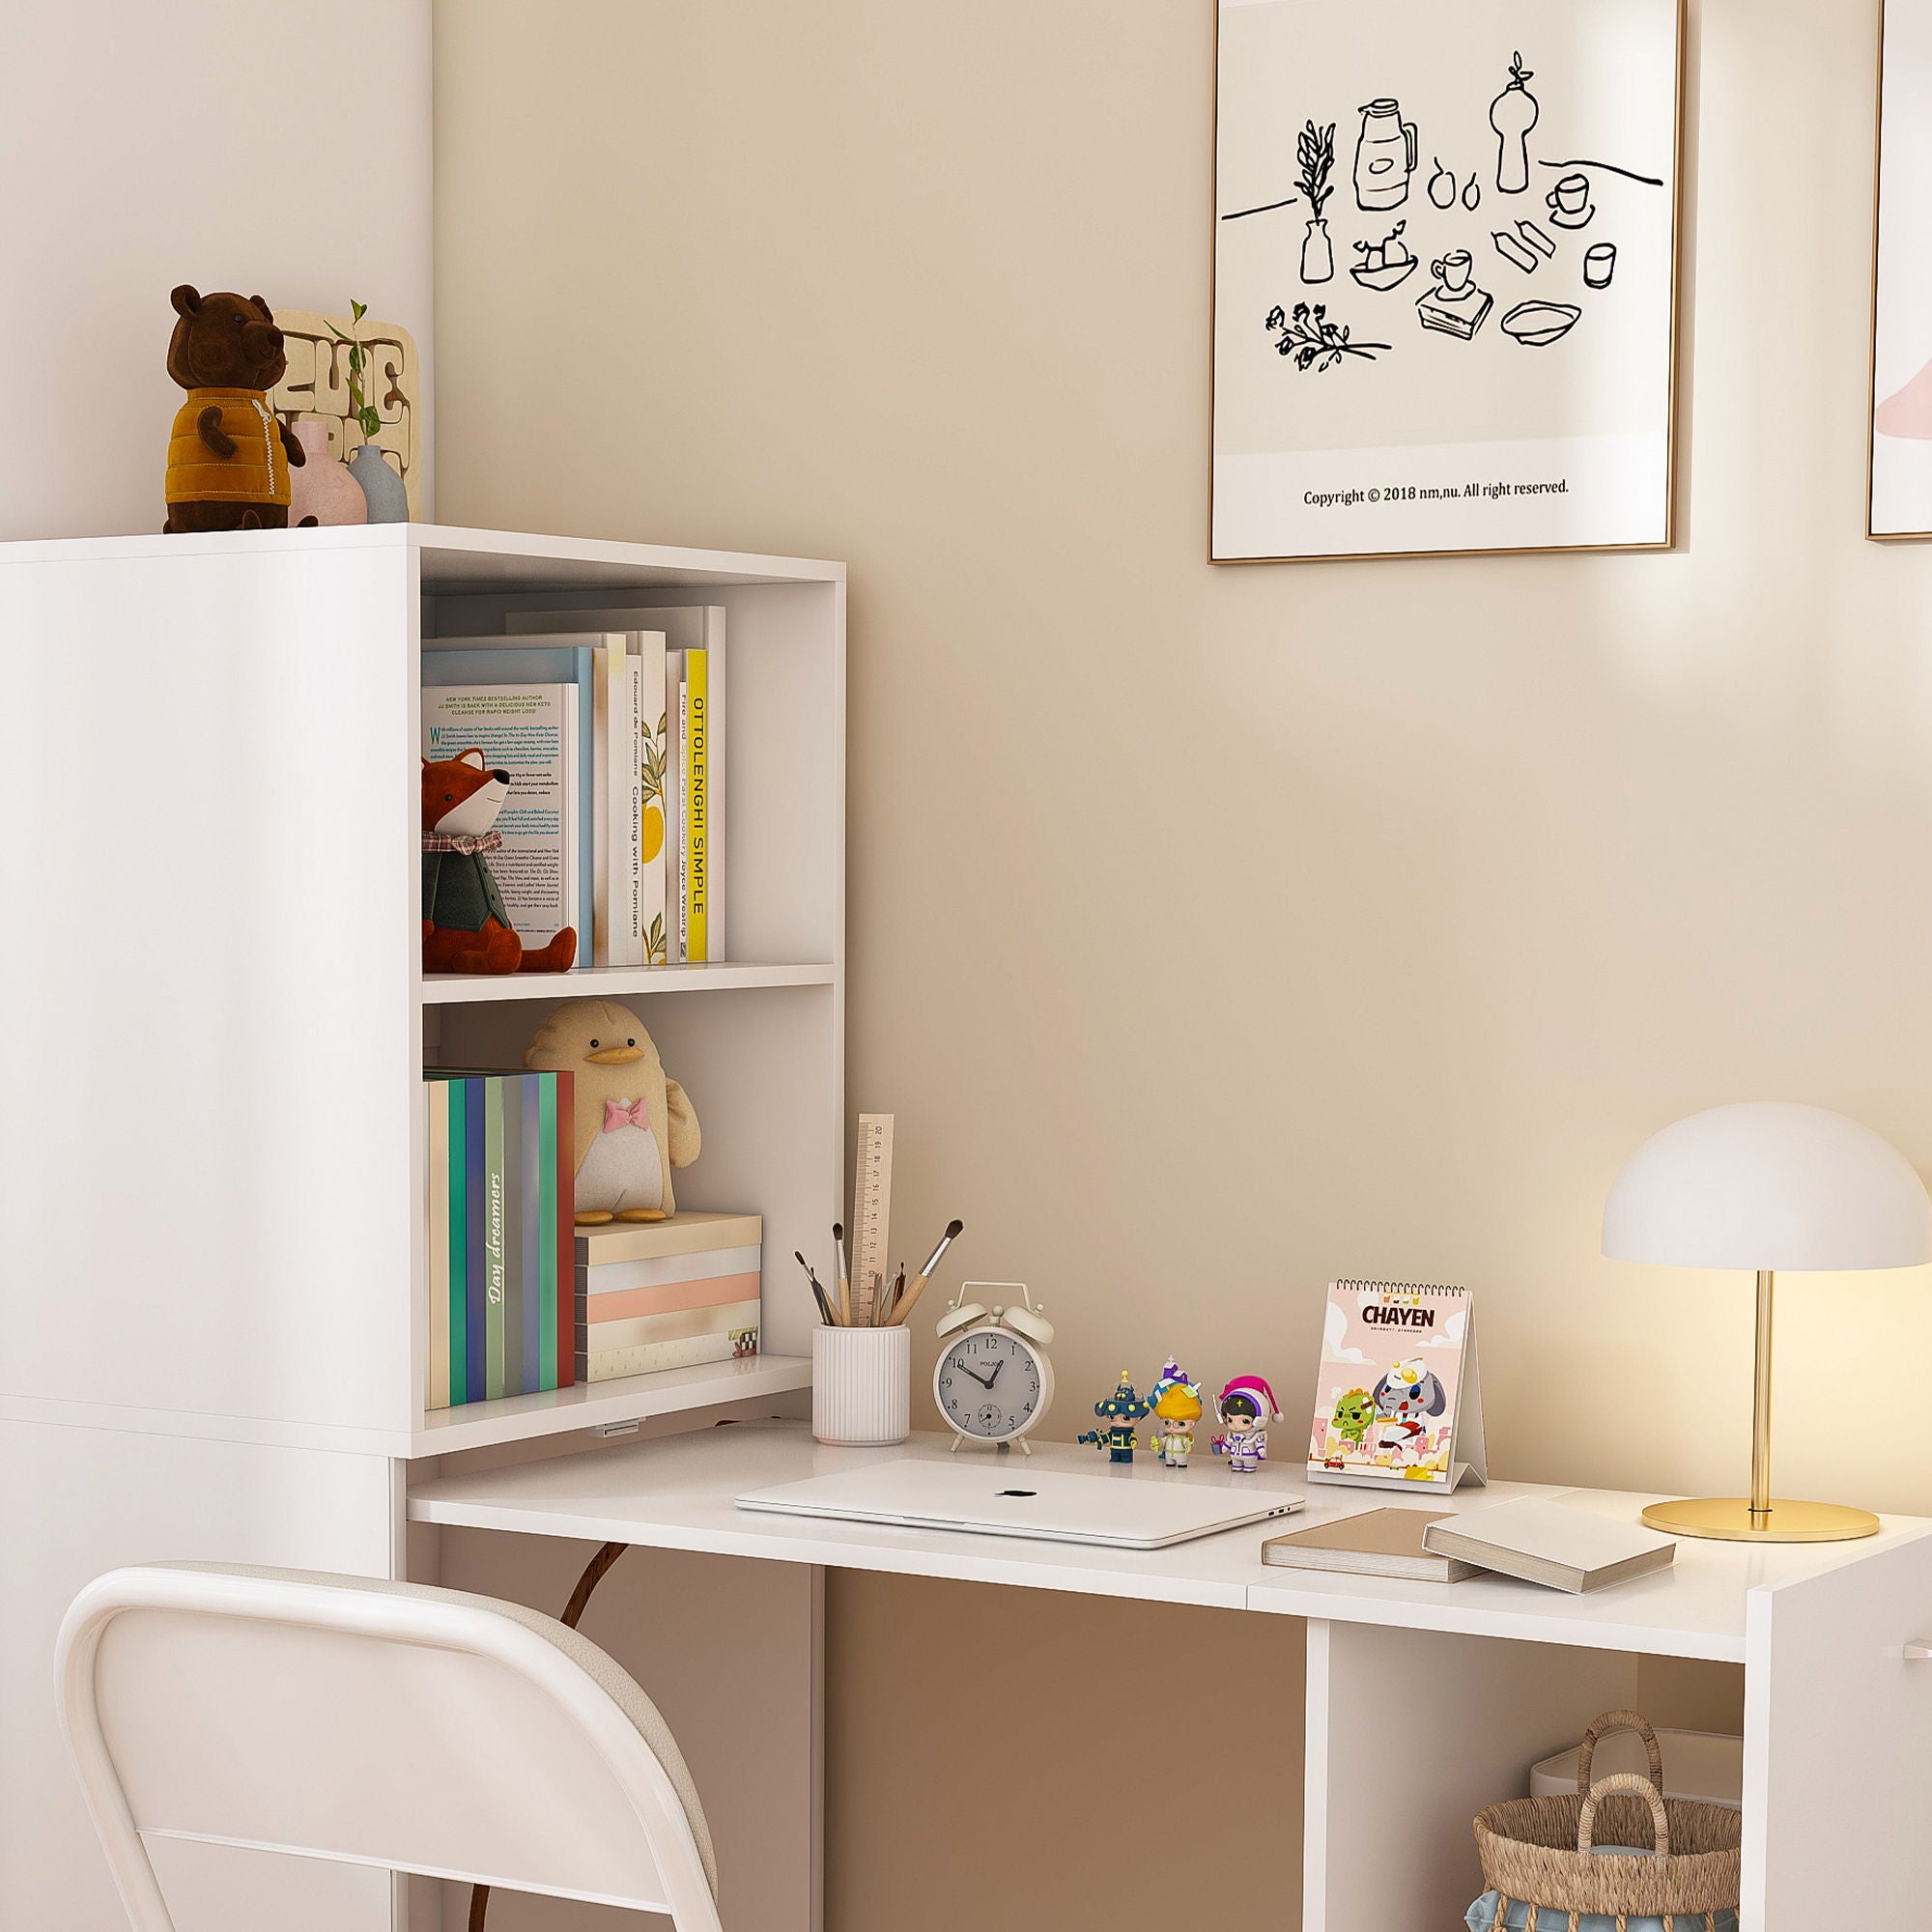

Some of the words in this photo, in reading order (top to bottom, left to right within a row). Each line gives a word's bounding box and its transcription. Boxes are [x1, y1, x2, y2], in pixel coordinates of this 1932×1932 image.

[1304, 489, 1364, 506] Copyright
[1384, 487, 1416, 500] 2018
[1420, 487, 1461, 500] nm,nu.
[1464, 483, 1479, 497] All
[1484, 482, 1511, 499] right
[1514, 479, 1569, 495] reserved.
[634, 717, 639, 728] de
[694, 697, 703, 828] OTTOLENGHI
[694, 838, 703, 914] SIMPLE
[486, 1173, 500, 1259] dreamers
[488, 1264, 504, 1305] Day
[1362, 1306, 1435, 1327] CHAYEN
[967, 1345, 977, 1353] 11
[985, 1339, 997, 1349] 12
[1011, 1346, 1014, 1355] 1
[952, 1357, 964, 1368] 10
[1025, 1360, 1031, 1371] 2
[946, 1378, 952, 1388] 9
[1030, 1381, 1035, 1391] 3
[952, 1399, 957, 1409] 8
[1024, 1403, 1030, 1412] 4
[965, 1414, 971, 1425] 7
[1009, 1415, 1014, 1426] 5
